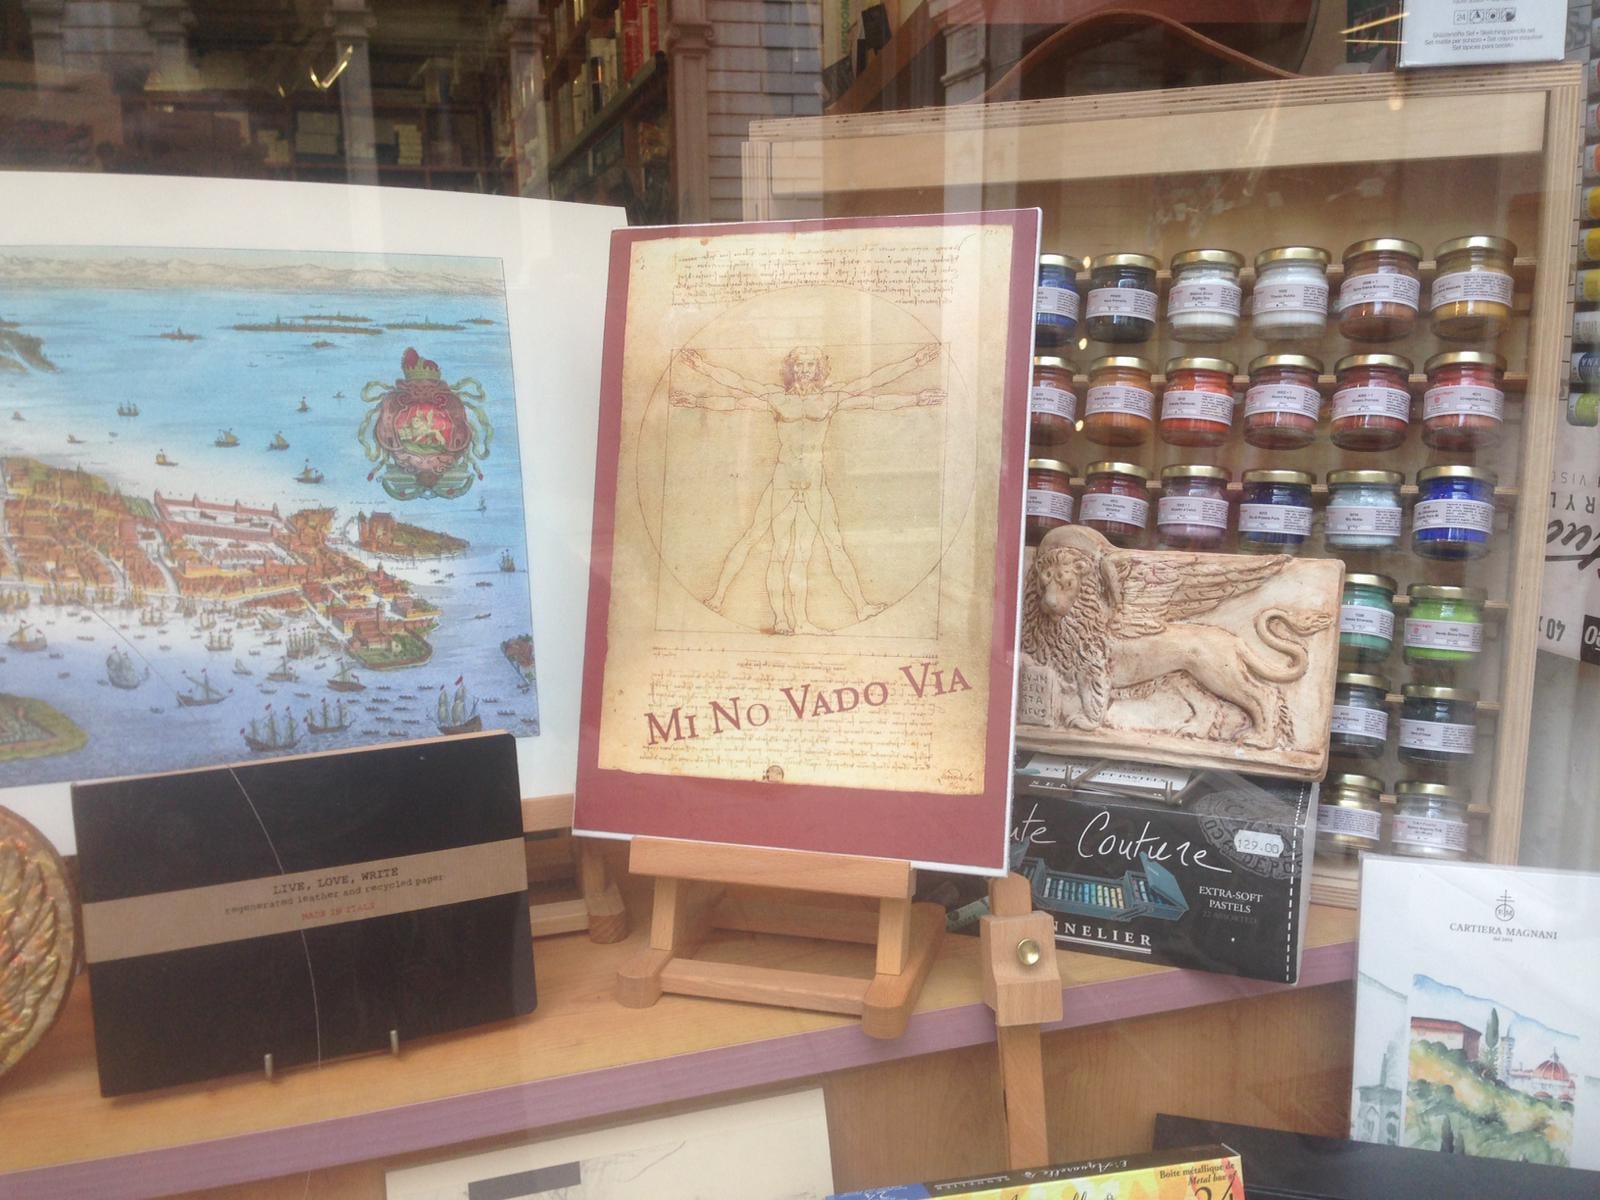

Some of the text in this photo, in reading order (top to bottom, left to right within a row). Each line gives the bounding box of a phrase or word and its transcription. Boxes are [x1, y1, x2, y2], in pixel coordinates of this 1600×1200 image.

[1078, 811, 1232, 874] Couture
[361, 867, 399, 881] WRITE
[343, 886, 361, 898] and
[1199, 886, 1263, 903] EXTRA-SOFT
[1209, 899, 1252, 913] PASTELS
[1449, 922, 1557, 940] CARTIERA MAGNANI
